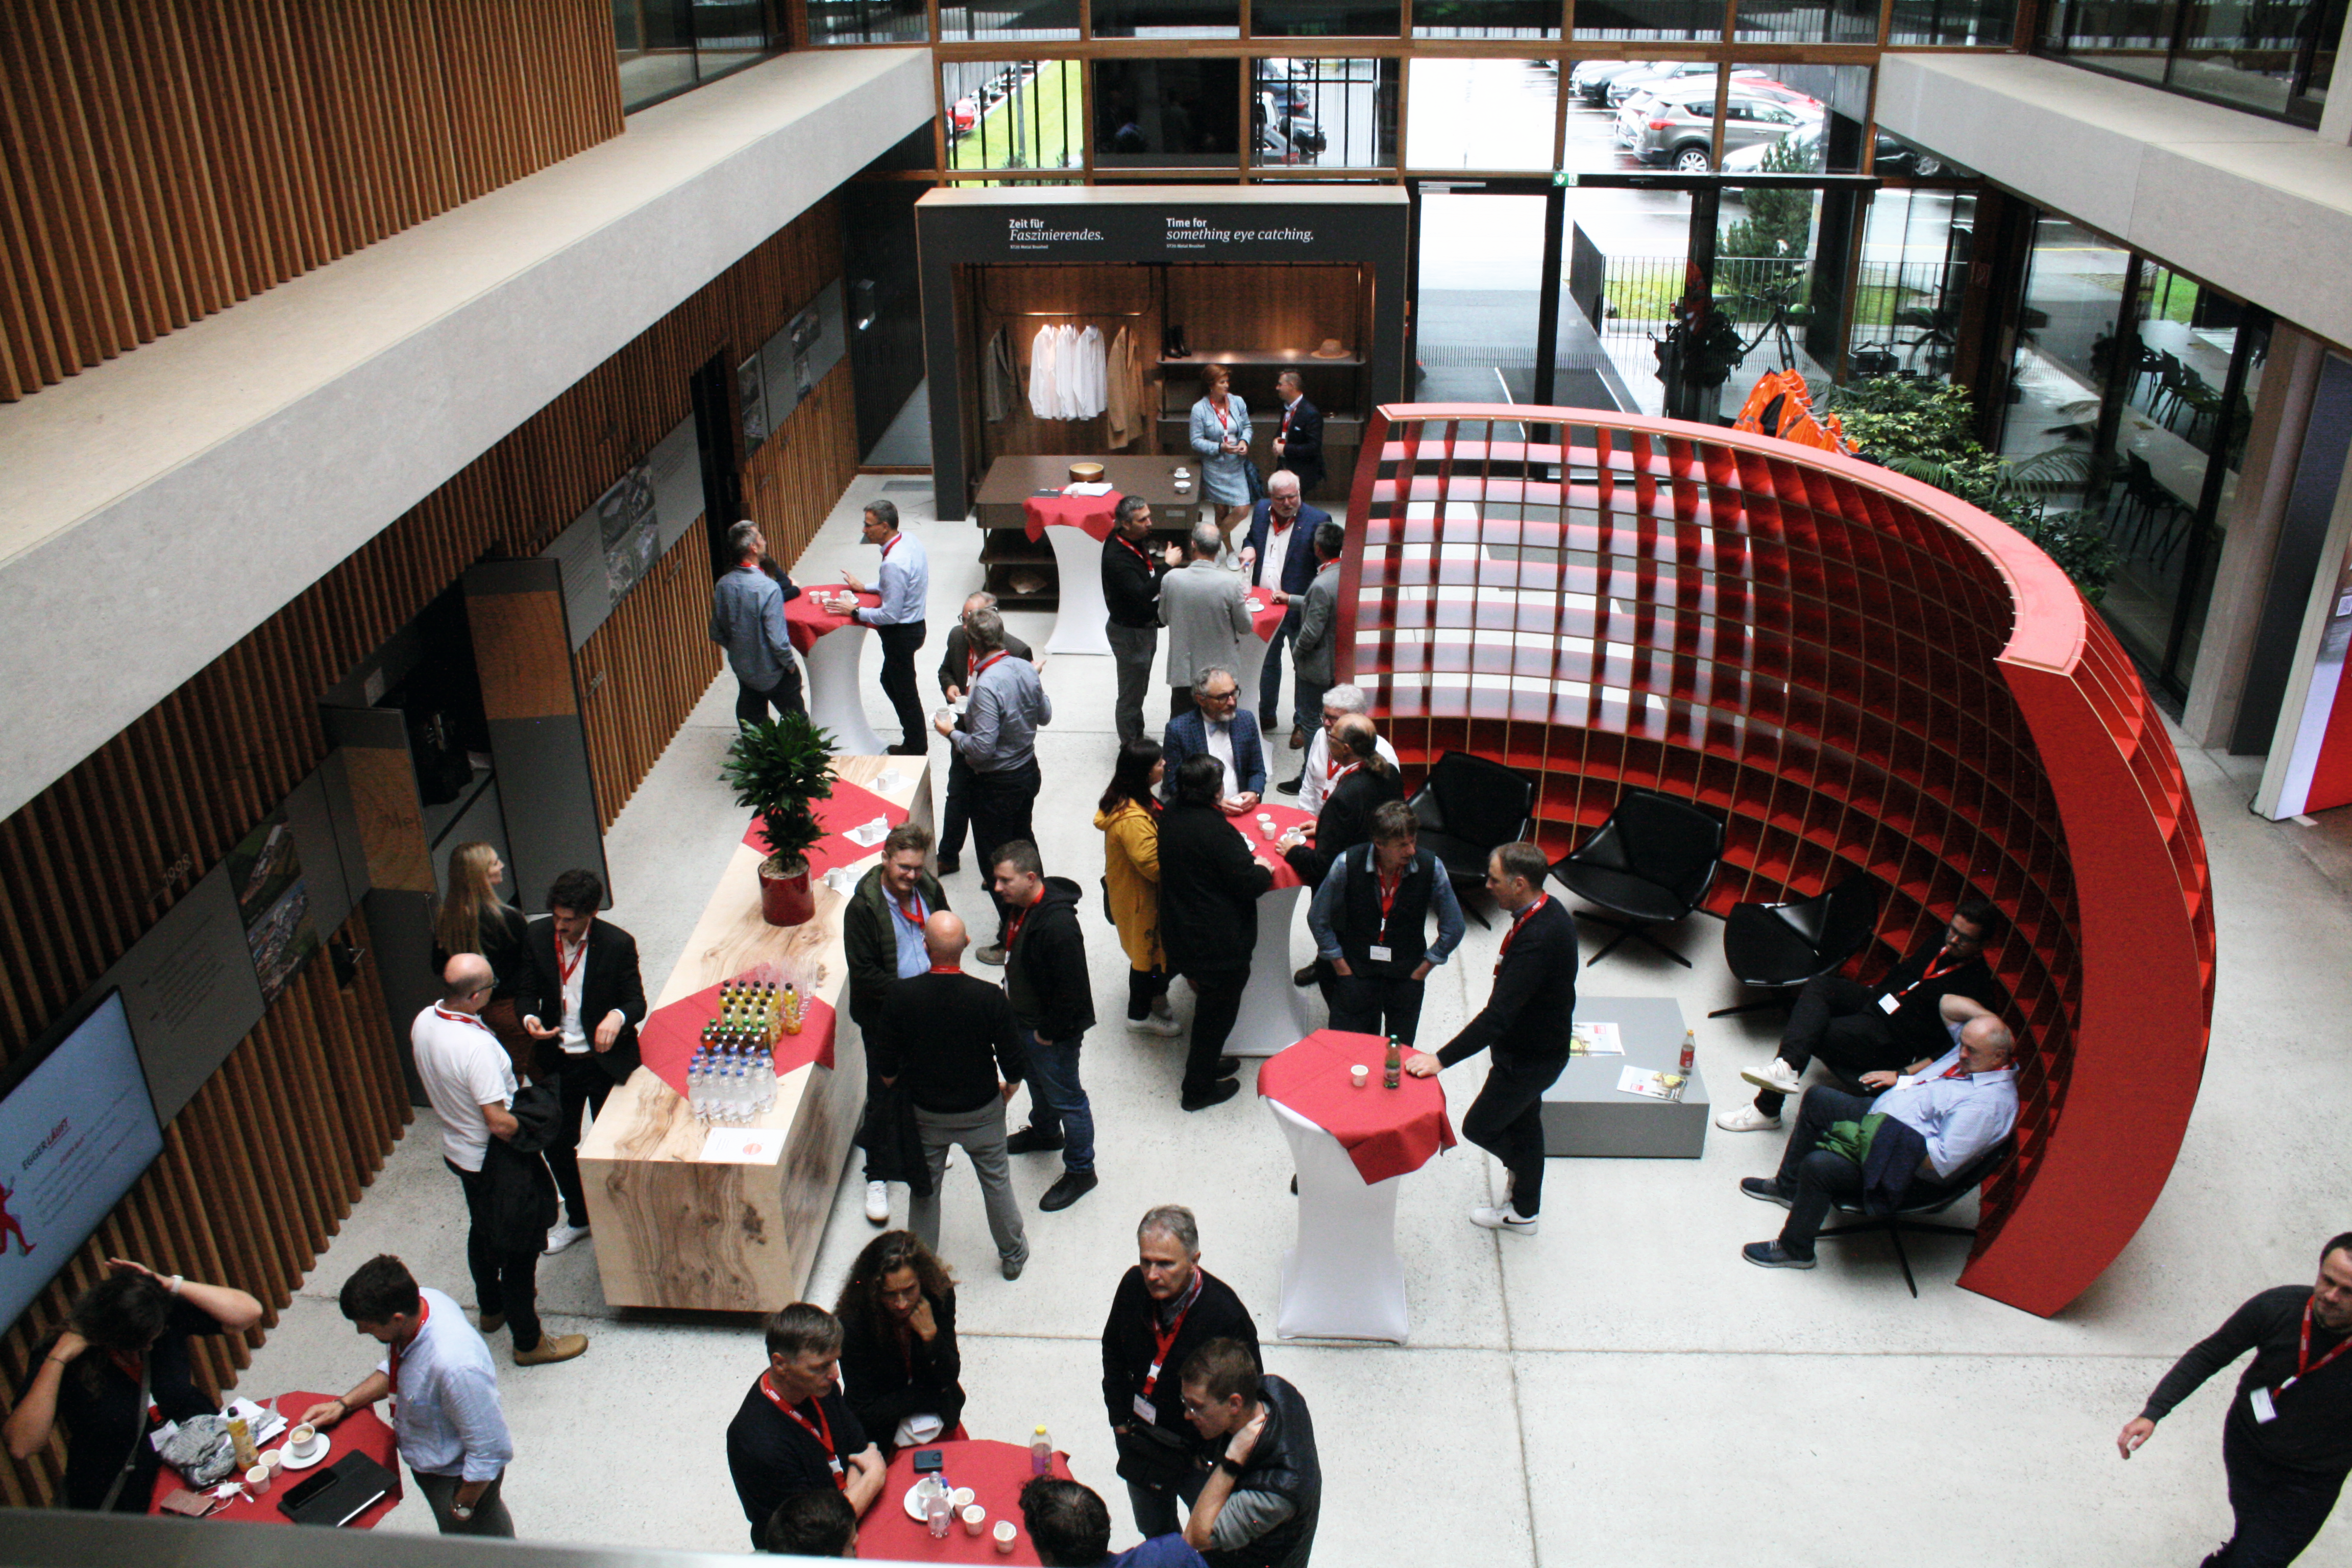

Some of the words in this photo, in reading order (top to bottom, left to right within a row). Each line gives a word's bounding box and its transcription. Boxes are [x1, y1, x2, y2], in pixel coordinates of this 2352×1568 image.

[1009, 219, 1028, 228] Zeit
[1030, 219, 1044, 228] für
[1166, 217, 1190, 228] Time
[1193, 217, 1207, 228] for
[1010, 228, 1104, 241] Faszinierendes.
[1166, 228, 1231, 242] something
[1234, 231, 1255, 242] eye
[1258, 228, 1314, 242] catching.
[163, 853, 192, 887] 1998
[22, 1141, 47, 1170] EGGER
